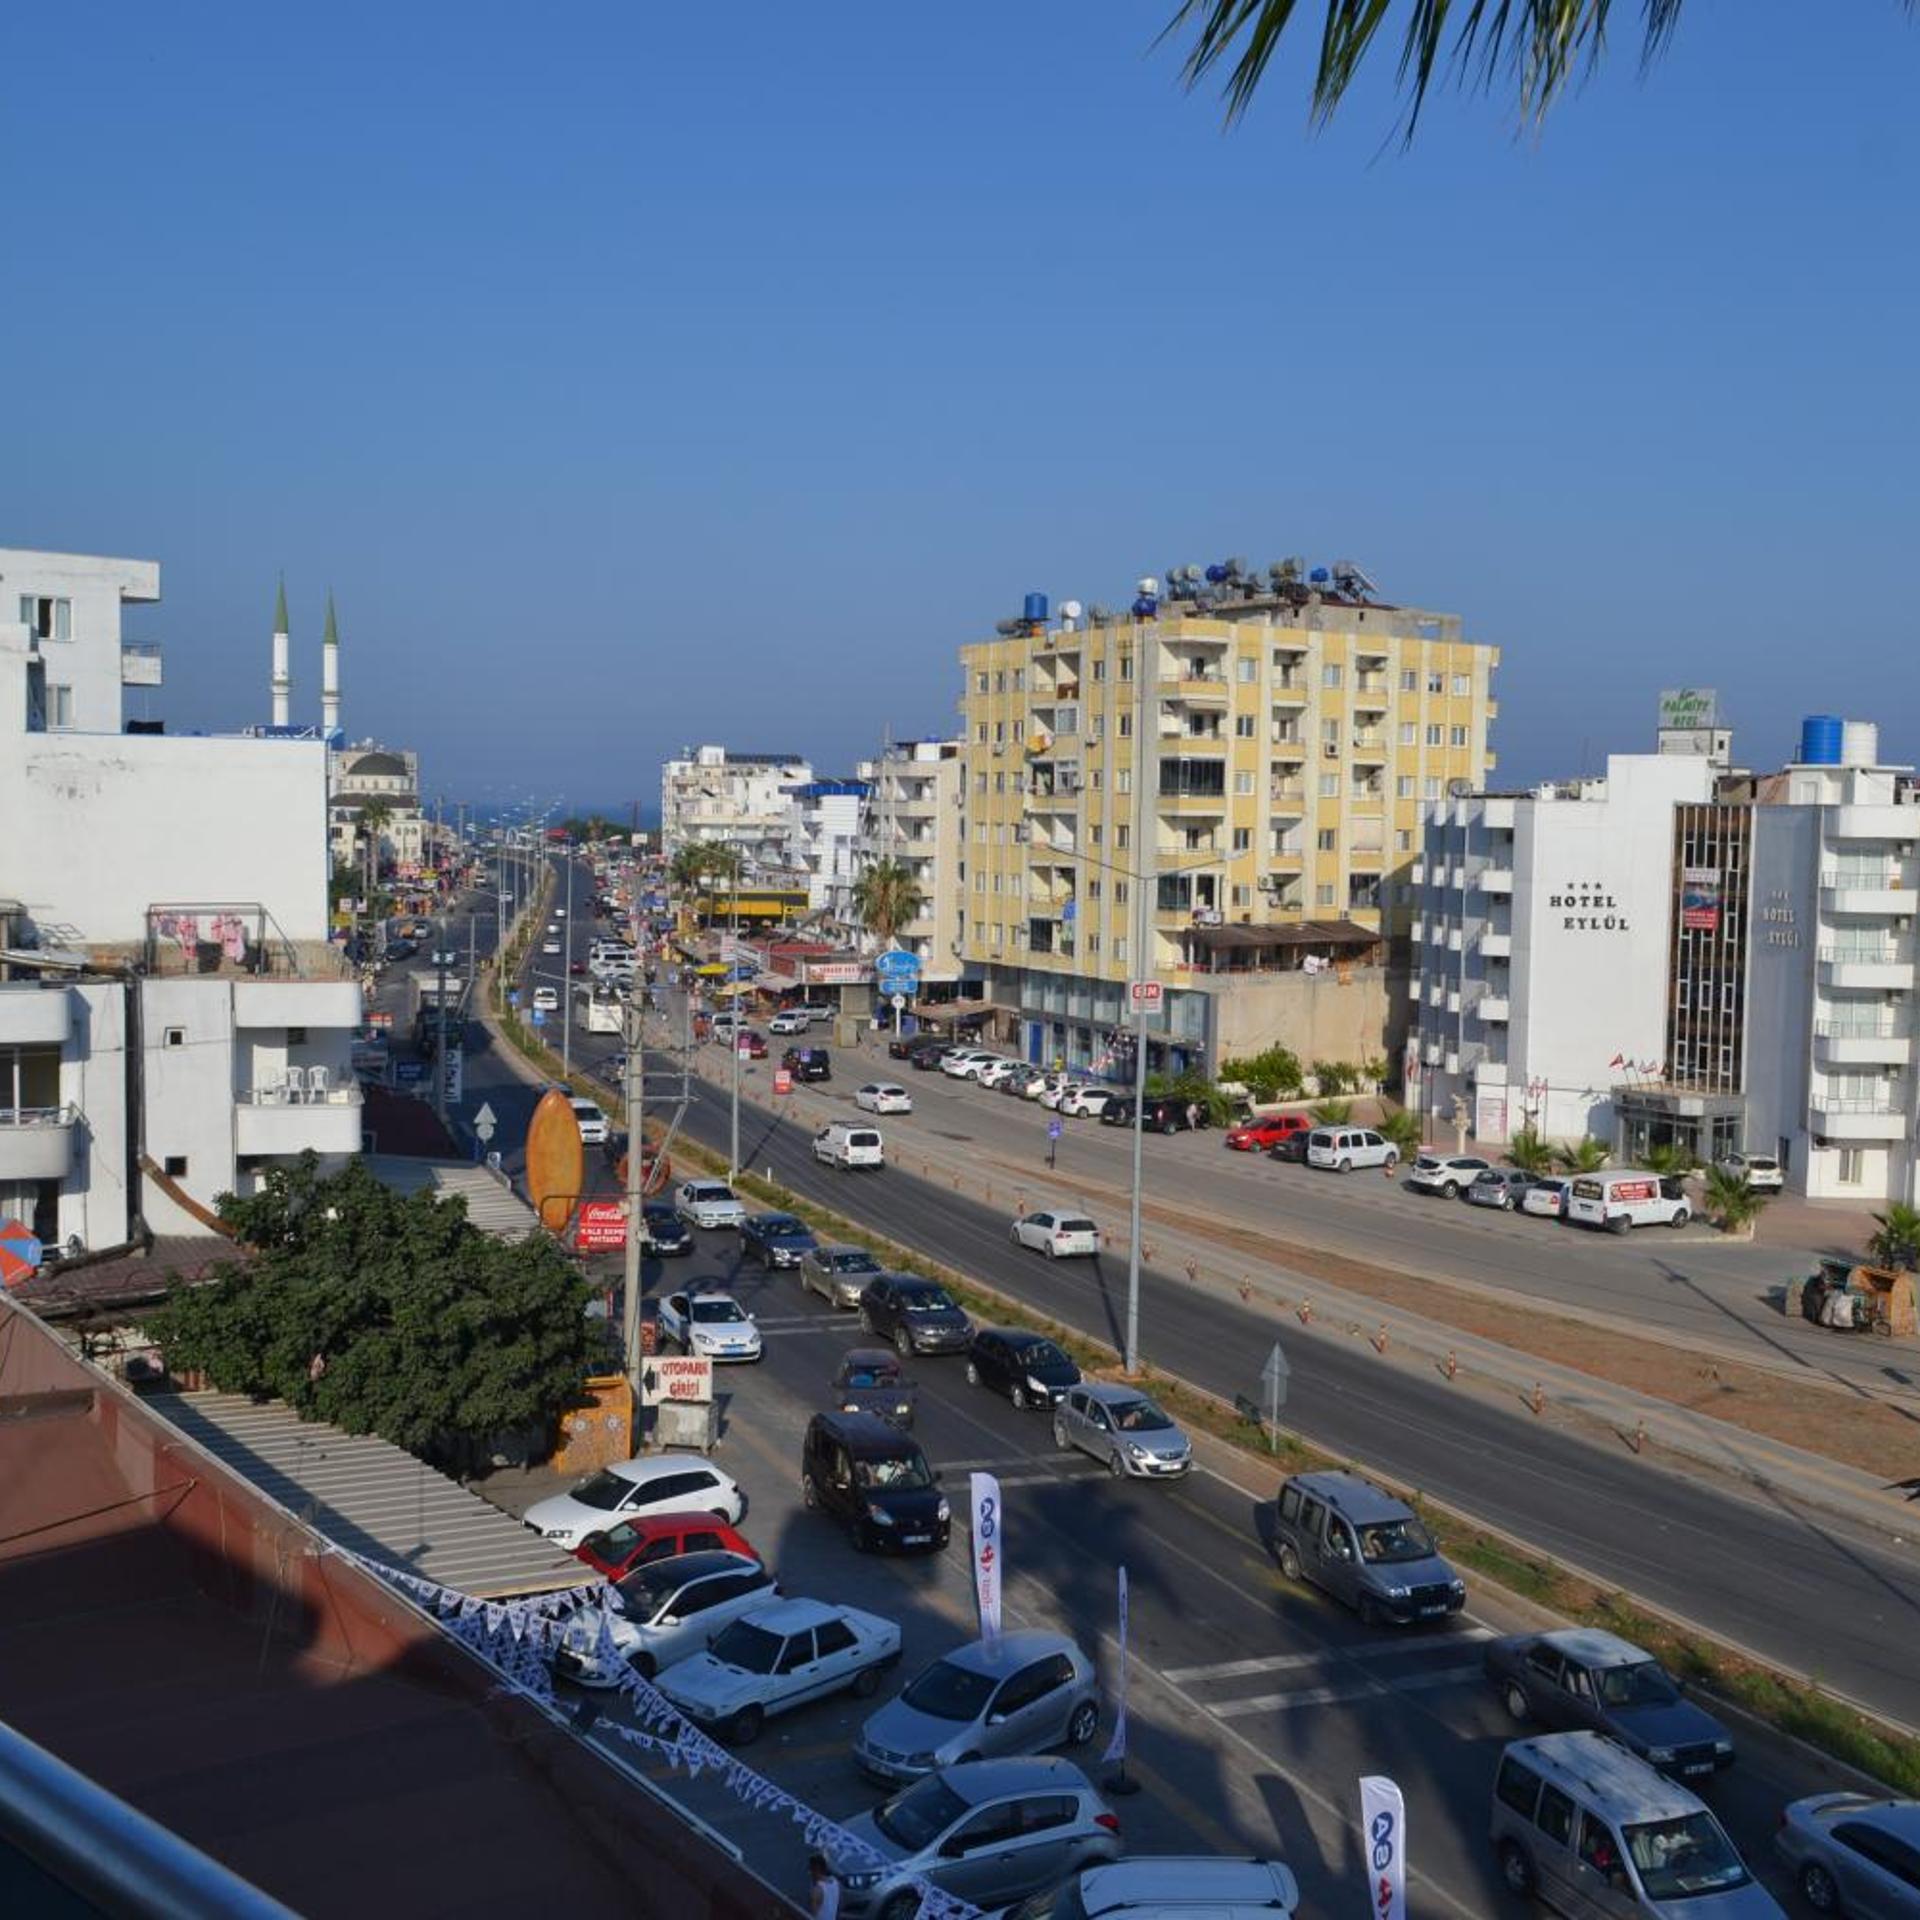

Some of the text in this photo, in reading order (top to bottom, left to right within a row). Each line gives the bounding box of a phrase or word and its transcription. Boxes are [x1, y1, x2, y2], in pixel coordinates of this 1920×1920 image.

[1549, 895, 1618, 908] HOTEL
[1563, 914, 1631, 931] EYLÜL
[661, 1360, 709, 1376] OTOPARK
